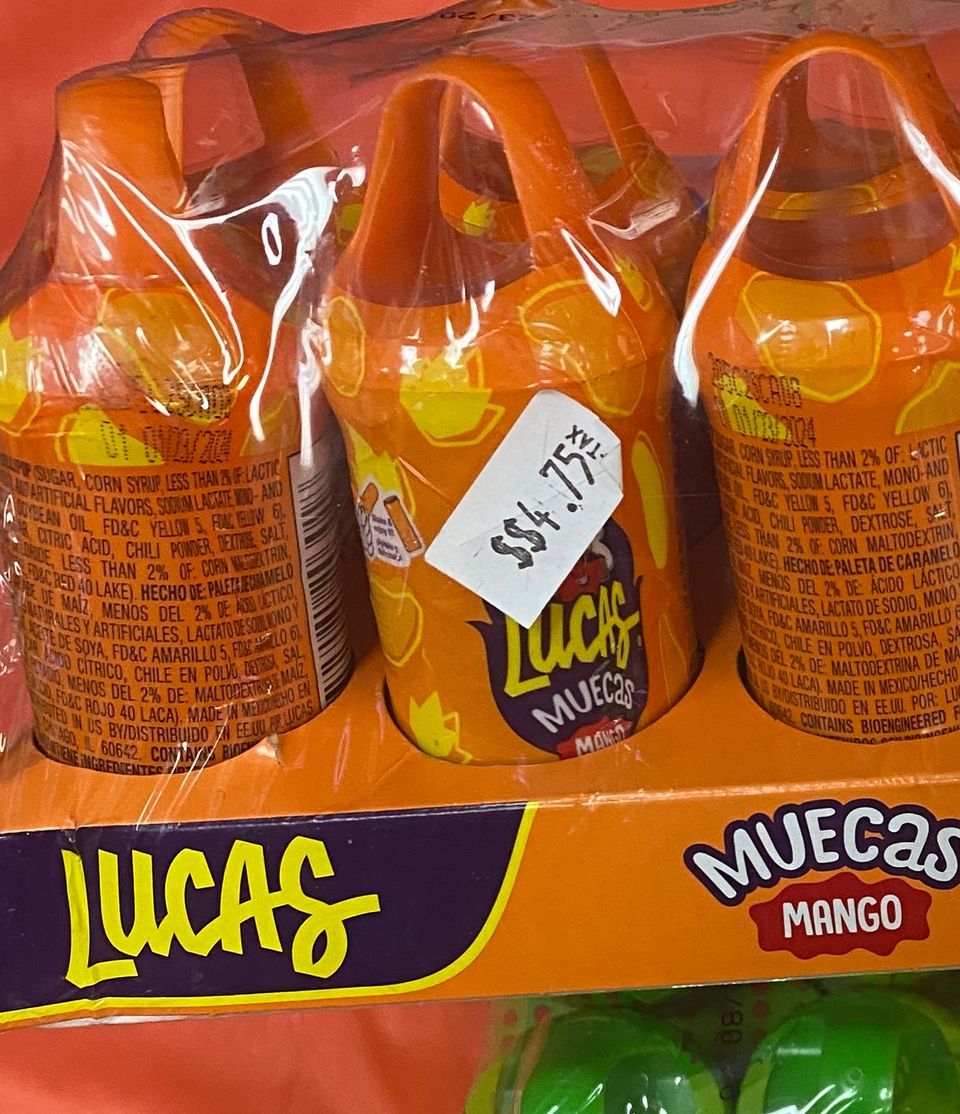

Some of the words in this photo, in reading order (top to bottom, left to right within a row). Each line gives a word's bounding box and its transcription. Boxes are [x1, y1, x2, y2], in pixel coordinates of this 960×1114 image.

[798, 450, 820, 468] LESS
[823, 450, 856, 468] THAN
[862, 449, 880, 466] 2%
[84, 474, 122, 493] CORN
[166, 472, 190, 492] LESS
[192, 470, 218, 489] THAN
[824, 470, 880, 490] LACTATE,
[94, 495, 157, 519] FLAVORS,
[842, 492, 876, 512] FD&C
[882, 485, 930, 509] YELLOW
[70, 513, 93, 536] OIL,
[102, 518, 139, 537] FD&C
[770, 512, 795, 532] CHILI
[850, 510, 918, 533] DEXTROSE,
[38, 527, 72, 550] CITRIC
[82, 536, 114, 560] ACID,
[126, 541, 160, 560] CHILI
[260, 522, 288, 544] SALT,
[829, 537, 858, 554] CORN
[866, 521, 959, 552] MALTODEXTRIN,
[62, 554, 91, 574] LESS
[101, 560, 136, 580] THAN
[147, 564, 169, 580] 2%
[783, 556, 818, 576] HECHO
[835, 557, 876, 576] PALETA
[878, 556, 895, 572] DE
[896, 541, 960, 571] CARAMELO
[798, 578, 820, 596] DEL
[870, 574, 904, 595] ÁCIDO
[102, 602, 149, 622] MENOS
[821, 600, 864, 617] LACTATO
[866, 598, 881, 615] DE
[882, 594, 922, 614] SODIO,
[923, 584, 957, 608] MONO
[93, 621, 186, 645] ARTIFICIALES,
[795, 617, 848, 638] AMARILLO
[862, 618, 892, 636] FD&C
[895, 606, 952, 633] AMARILLO
[74, 637, 108, 662] SOYA,
[112, 644, 147, 662] FD&C
[152, 645, 217, 663] AMARILLO
[503, 580, 640, 697] LUCAS
[784, 634, 813, 654] CHILE
[818, 640, 832, 656] EN
[880, 632, 942, 655] DEXTROSA,
[77, 658, 128, 683] CÍTRICO,
[134, 666, 172, 683] CHILE
[180, 667, 197, 683] EN
[831, 655, 920, 676] MALTODEXTRINA
[924, 651, 941, 668] DE
[68, 674, 106, 698] MENOS
[112, 683, 137, 701] DEL
[140, 686, 162, 704] 2%
[168, 688, 189, 704] DE:
[826, 679, 860, 696] MADE
[864, 680, 876, 696] IN
[878, 666, 958, 695] MEXICO/HECHO
[56, 689, 82, 711] FD&C
[85, 698, 115, 718] ROJO
[120, 705, 136, 722] 40
[140, 706, 182, 727] LACA).
[188, 706, 223, 724] MADE
[852, 700, 868, 715] EN
[912, 692, 938, 711] POR:
[88, 718, 102, 736] US
[109, 722, 208, 744] BY/DISTRIBUIDO
[283, 700, 314, 726] LUCAS
[800, 712, 854, 734] CONTAINS
[862, 710, 946, 734] BIOENGINEERED
[61, 835, 381, 989] LUCAS
[783, 894, 902, 938] MANGO
